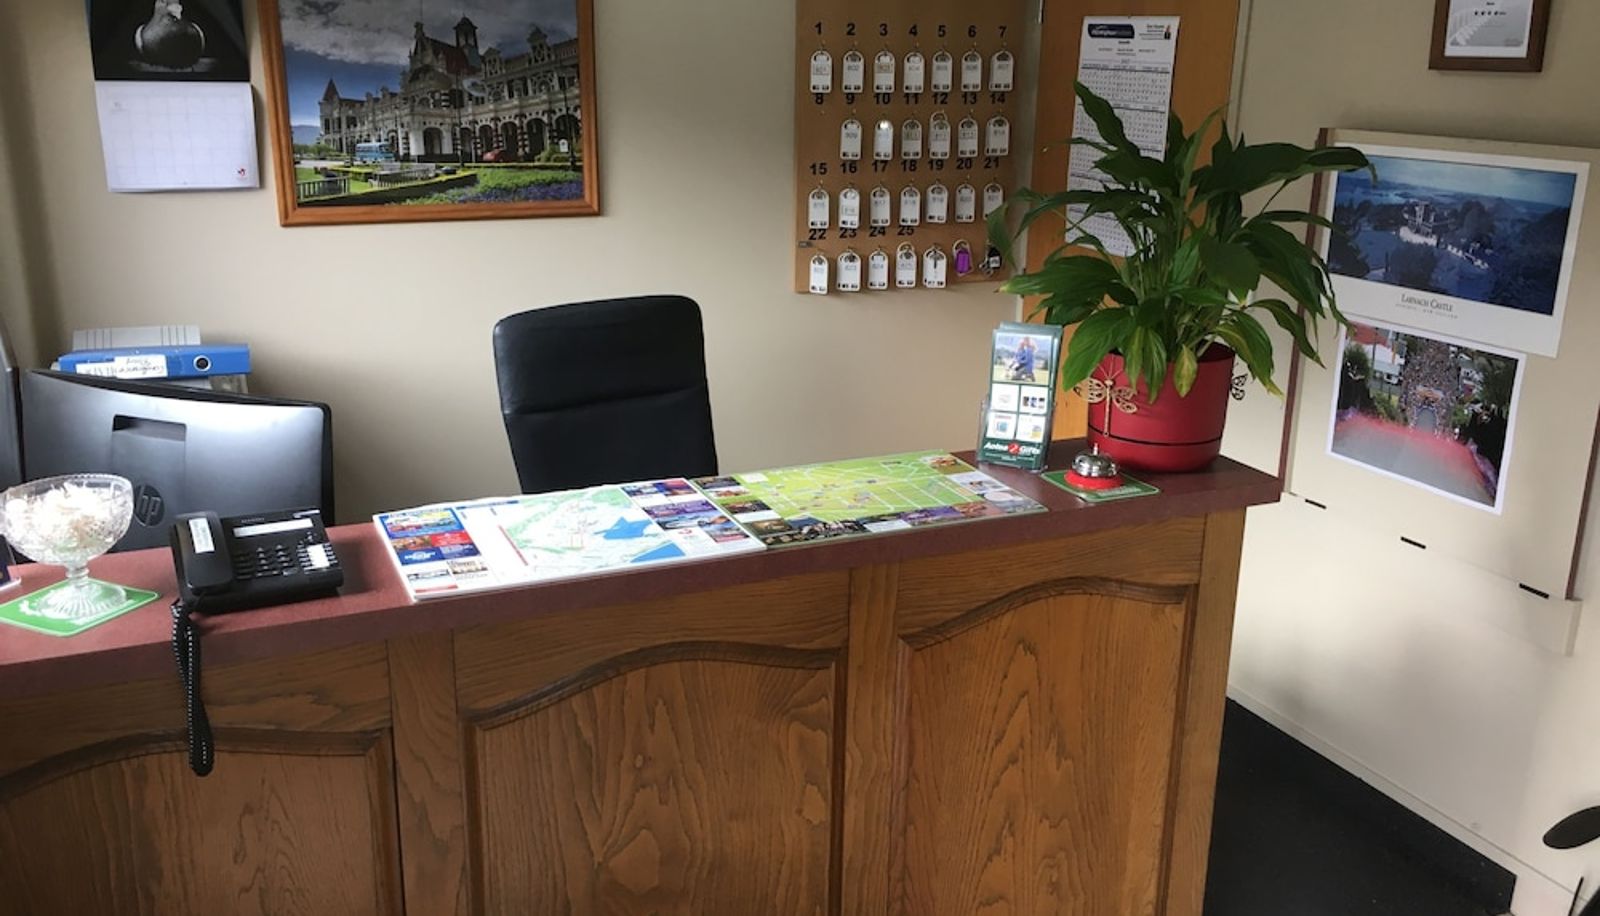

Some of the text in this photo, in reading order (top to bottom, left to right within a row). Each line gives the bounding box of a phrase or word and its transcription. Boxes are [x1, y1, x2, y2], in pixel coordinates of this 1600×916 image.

[814, 21, 1008, 39] 1 2 3 4 5 6 7
[814, 92, 1005, 105] 8 9 10 11 12 13 14
[809, 155, 1000, 176] 15 16 17 18 19 20 21
[808, 226, 915, 241] 22 23 24 25
[135, 485, 161, 526] hp
